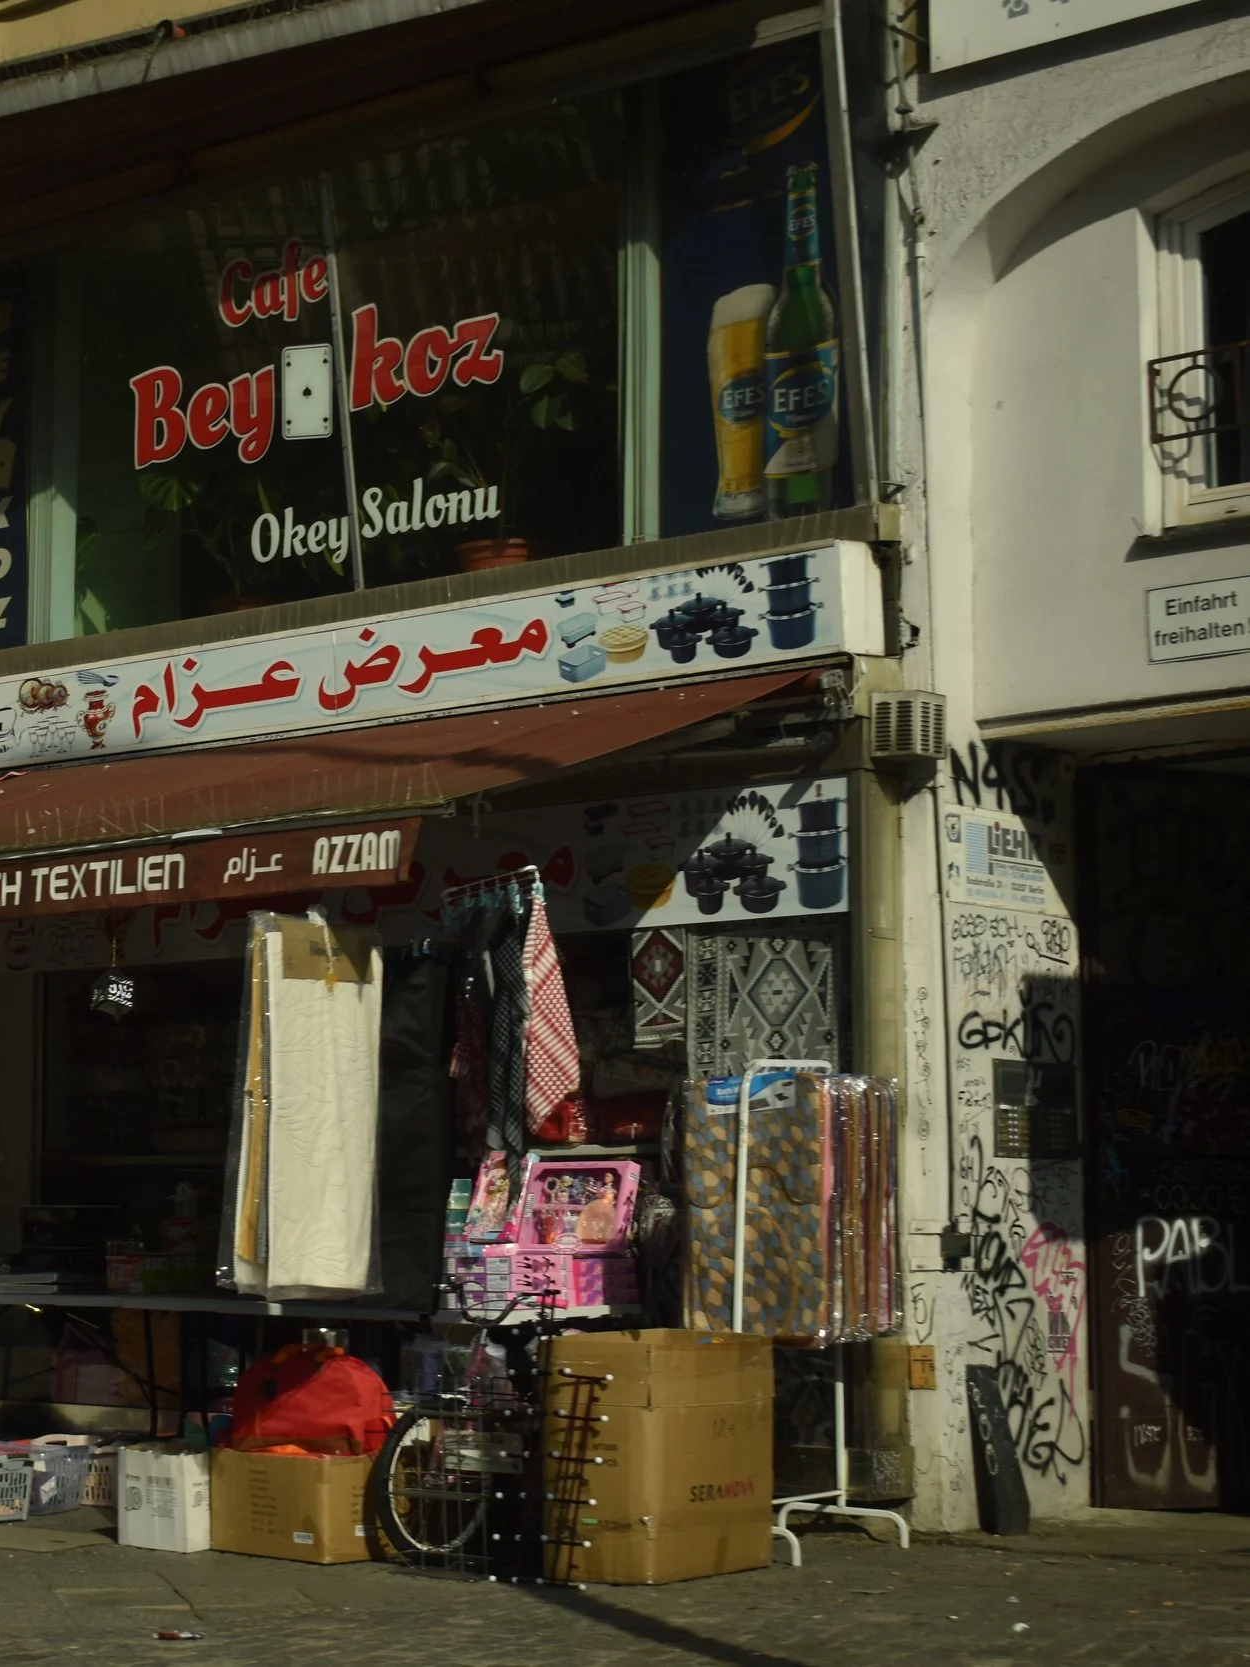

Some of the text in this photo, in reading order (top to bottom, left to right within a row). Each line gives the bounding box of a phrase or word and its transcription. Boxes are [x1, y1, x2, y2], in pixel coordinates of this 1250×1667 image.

[218, 236, 328, 328] Cafe
[772, 378, 830, 414] EFES
[250, 479, 501, 564] Okey Salonu
[1165, 591, 1238, 616] Einfahrt
[131, 617, 549, 740] معرض عزام
[223, 847, 283, 884] عزام
[312, 829, 401, 875] AZZAM
[31, 853, 185, 902] TEXTILIEN
